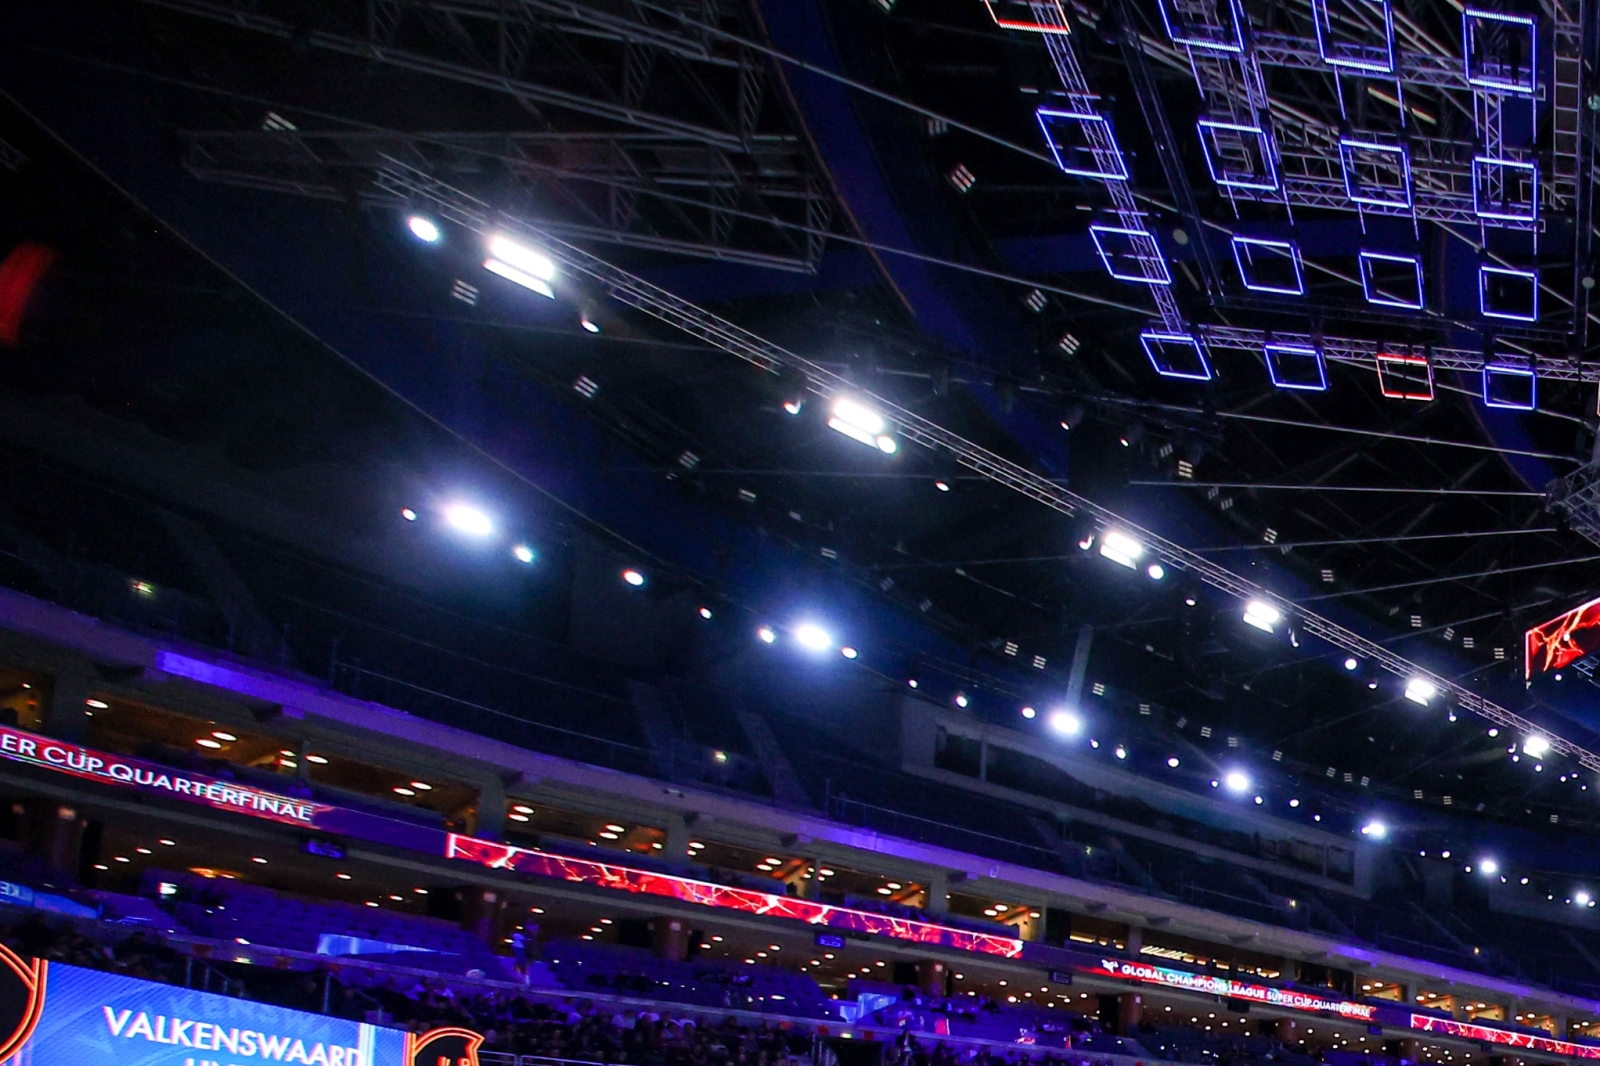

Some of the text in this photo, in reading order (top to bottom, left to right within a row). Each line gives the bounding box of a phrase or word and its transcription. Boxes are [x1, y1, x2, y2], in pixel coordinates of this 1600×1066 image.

[0, 733, 314, 821] ER CUP QUARTERFINAL
[1122, 965, 1370, 1017] GLOBAL CHAMPIONS LEAGUE SUPER CUP QUARTERFINAL
